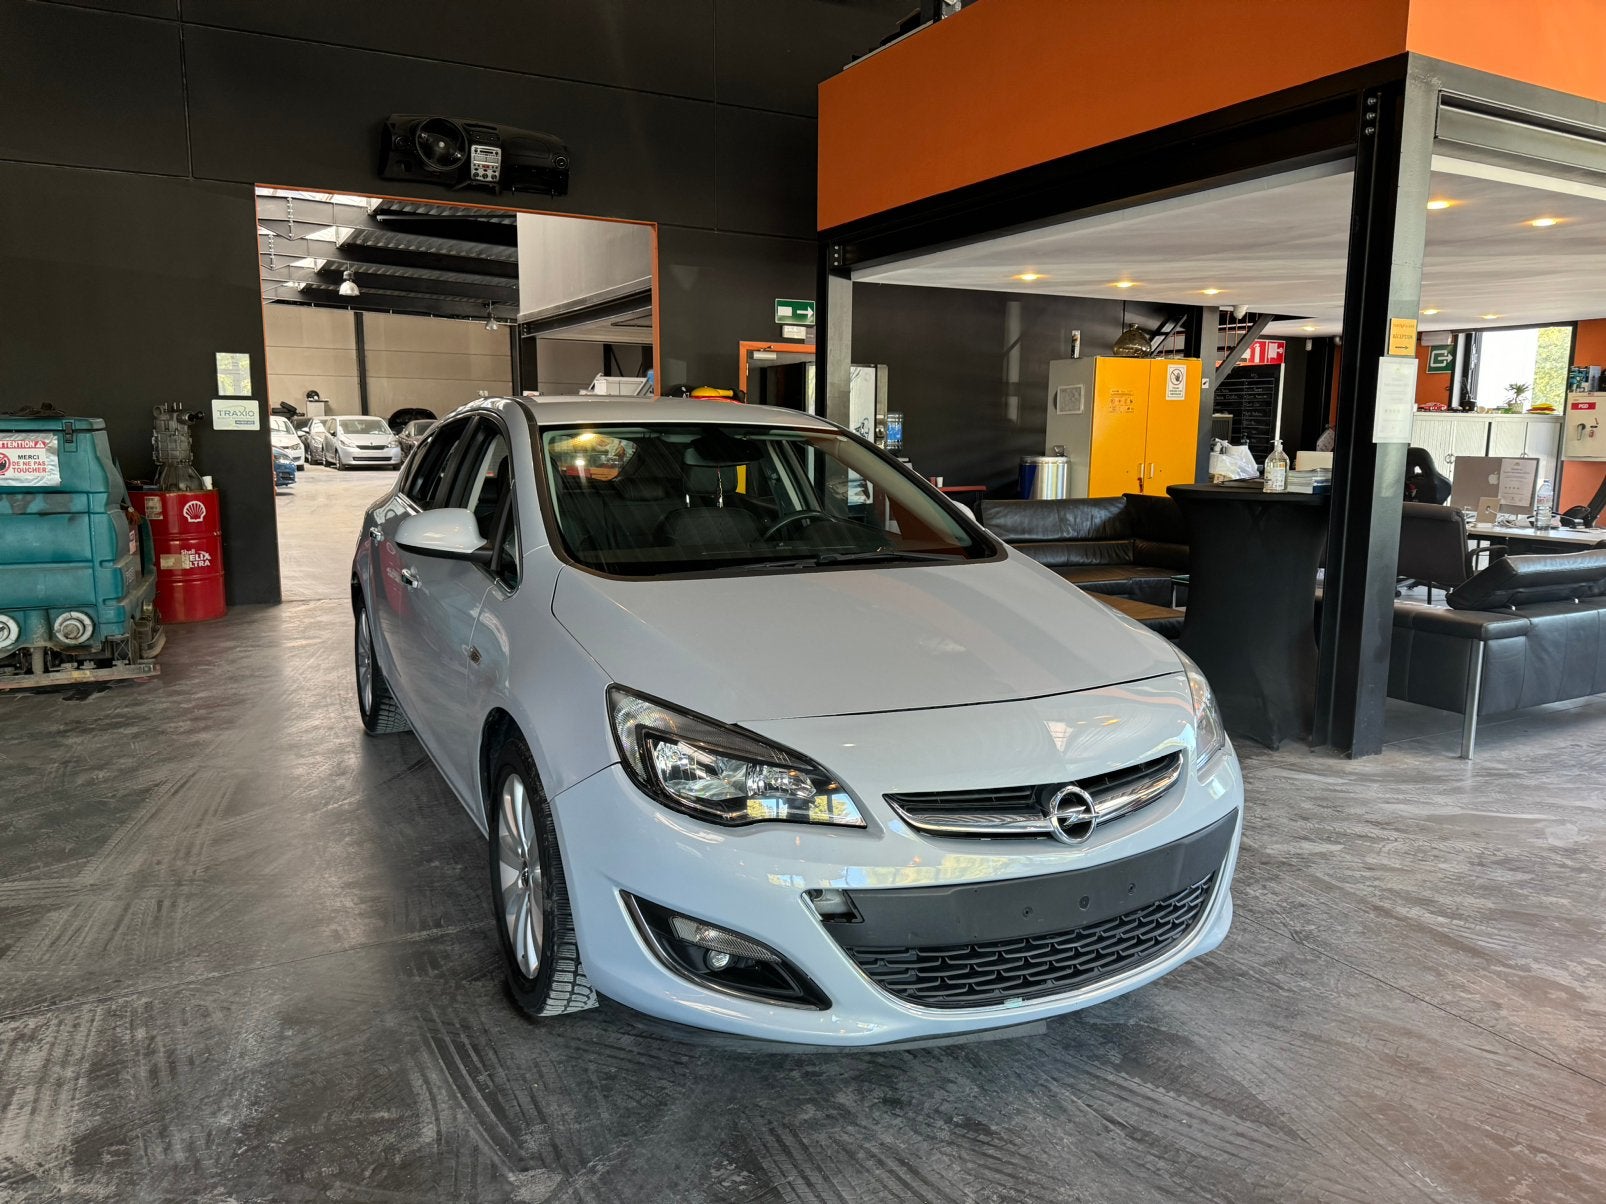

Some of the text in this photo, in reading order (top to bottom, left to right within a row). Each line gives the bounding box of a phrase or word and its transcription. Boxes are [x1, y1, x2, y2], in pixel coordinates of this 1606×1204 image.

[216, 409, 255, 417] TRAXIO
[0, 440, 34, 448] TTENTION
[189, 552, 212, 561] ELIX
[189, 560, 211, 568] LTRA
